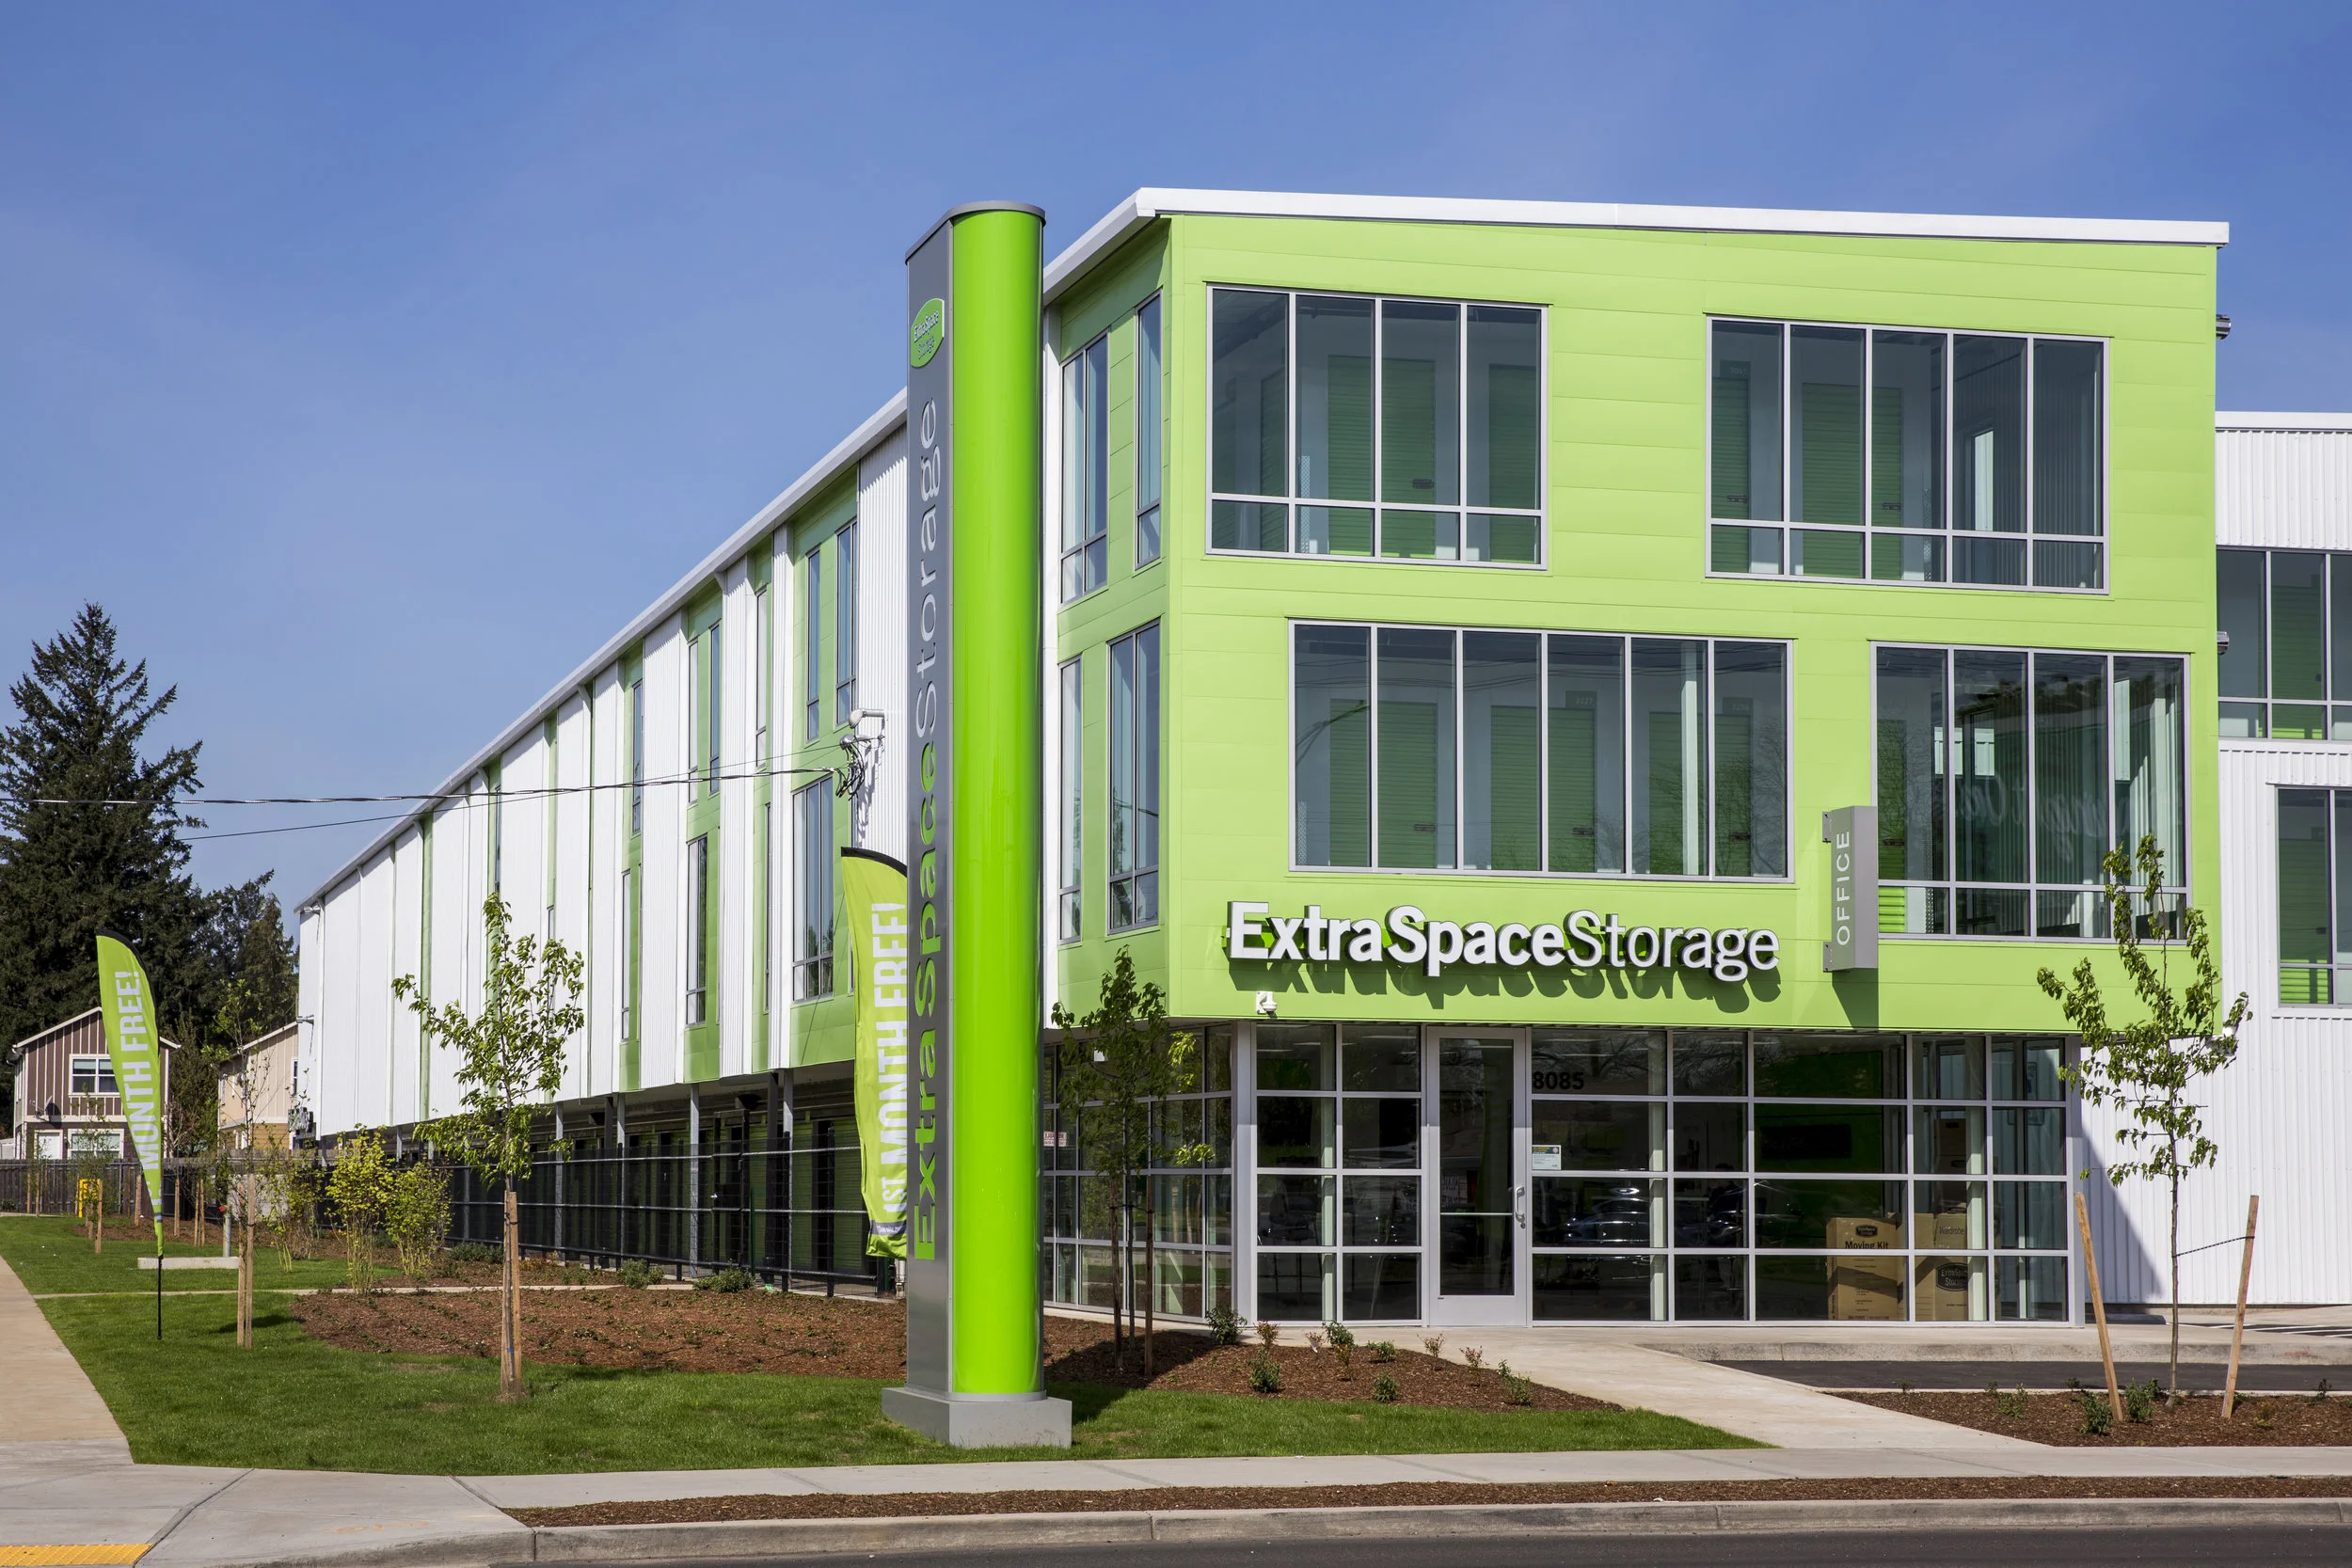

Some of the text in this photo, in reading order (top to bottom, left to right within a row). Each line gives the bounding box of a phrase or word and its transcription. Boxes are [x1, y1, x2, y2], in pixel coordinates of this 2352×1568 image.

[1836, 832, 1851, 945] OFFICE
[115, 971, 149, 1052] FREE!
[122, 1061, 159, 1170] MONTH
[876, 1021, 907, 1164] MONTH
[1533, 1070, 1584, 1090] 8085
[1845, 1241, 1889, 1249] Moving Kit
